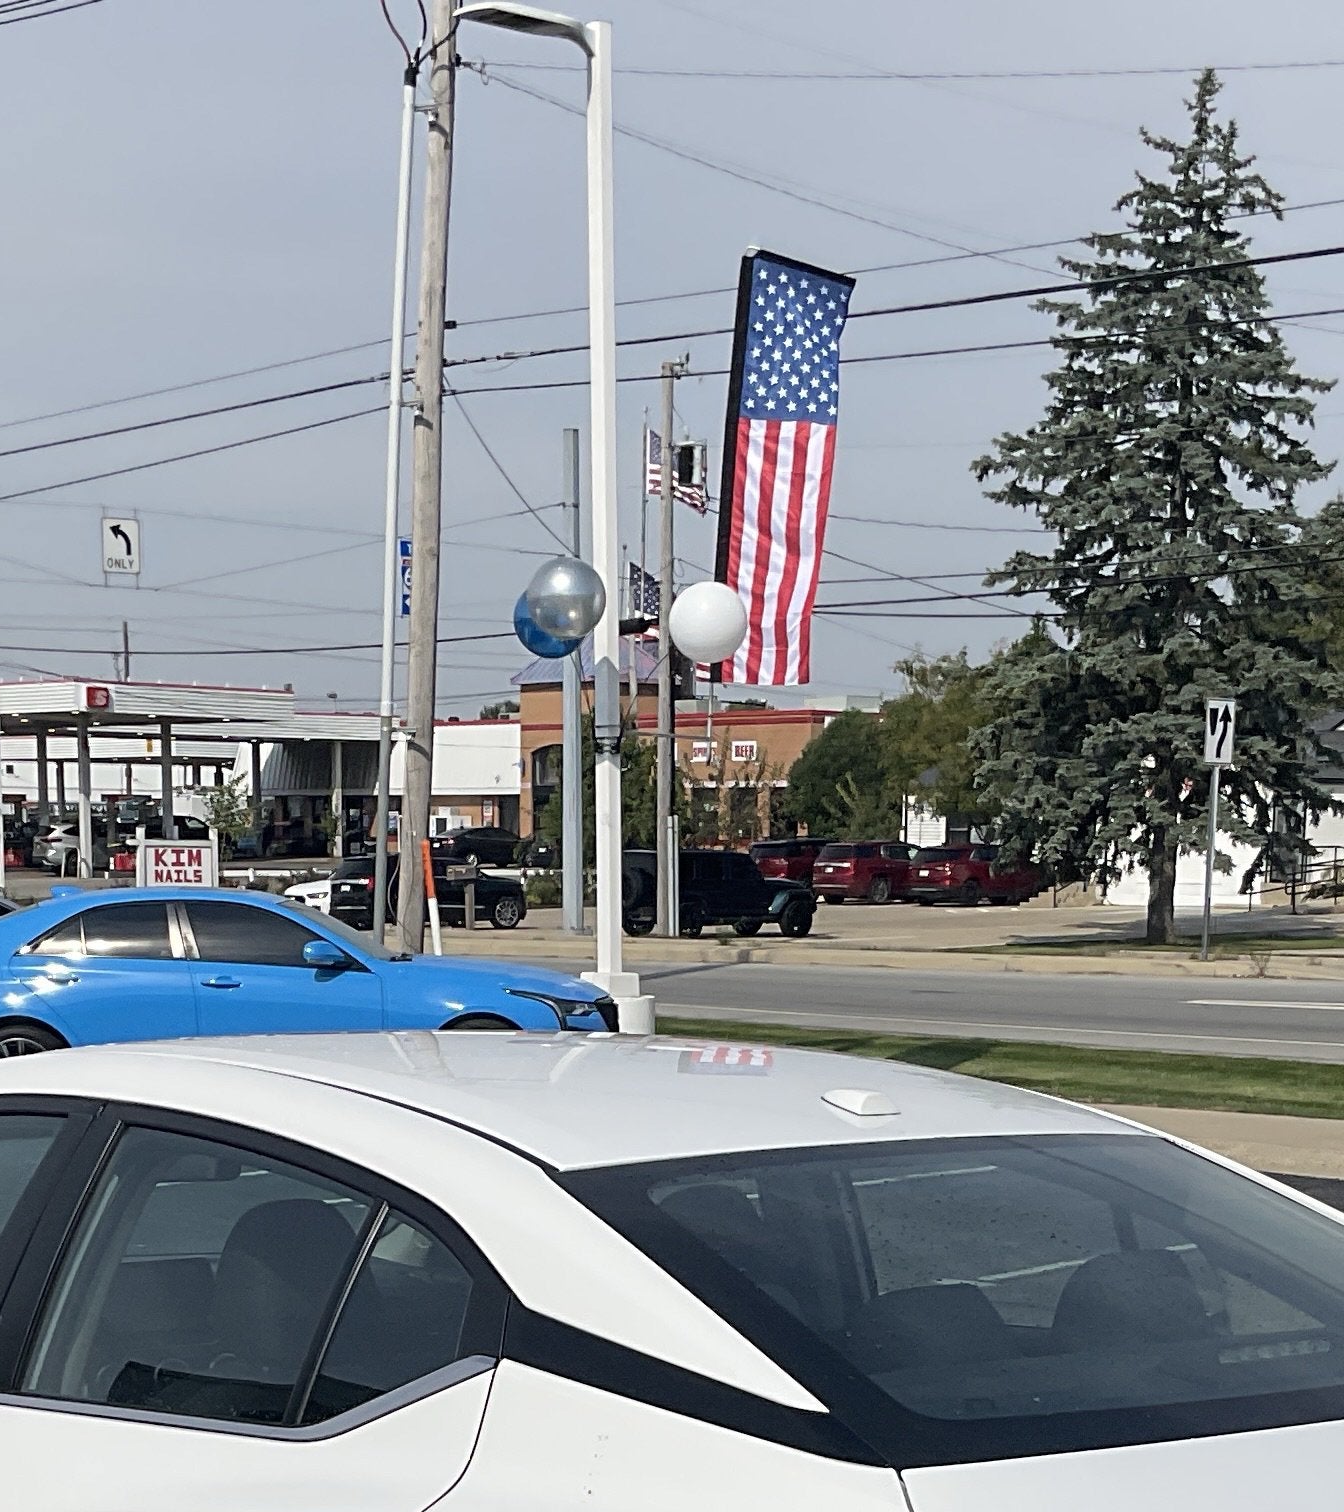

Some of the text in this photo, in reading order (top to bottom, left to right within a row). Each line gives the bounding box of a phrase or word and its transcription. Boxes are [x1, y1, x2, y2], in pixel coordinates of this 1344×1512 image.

[107, 557, 134, 570] ONLY
[154, 848, 202, 867] KIM
[154, 869, 203, 883] NAILS
